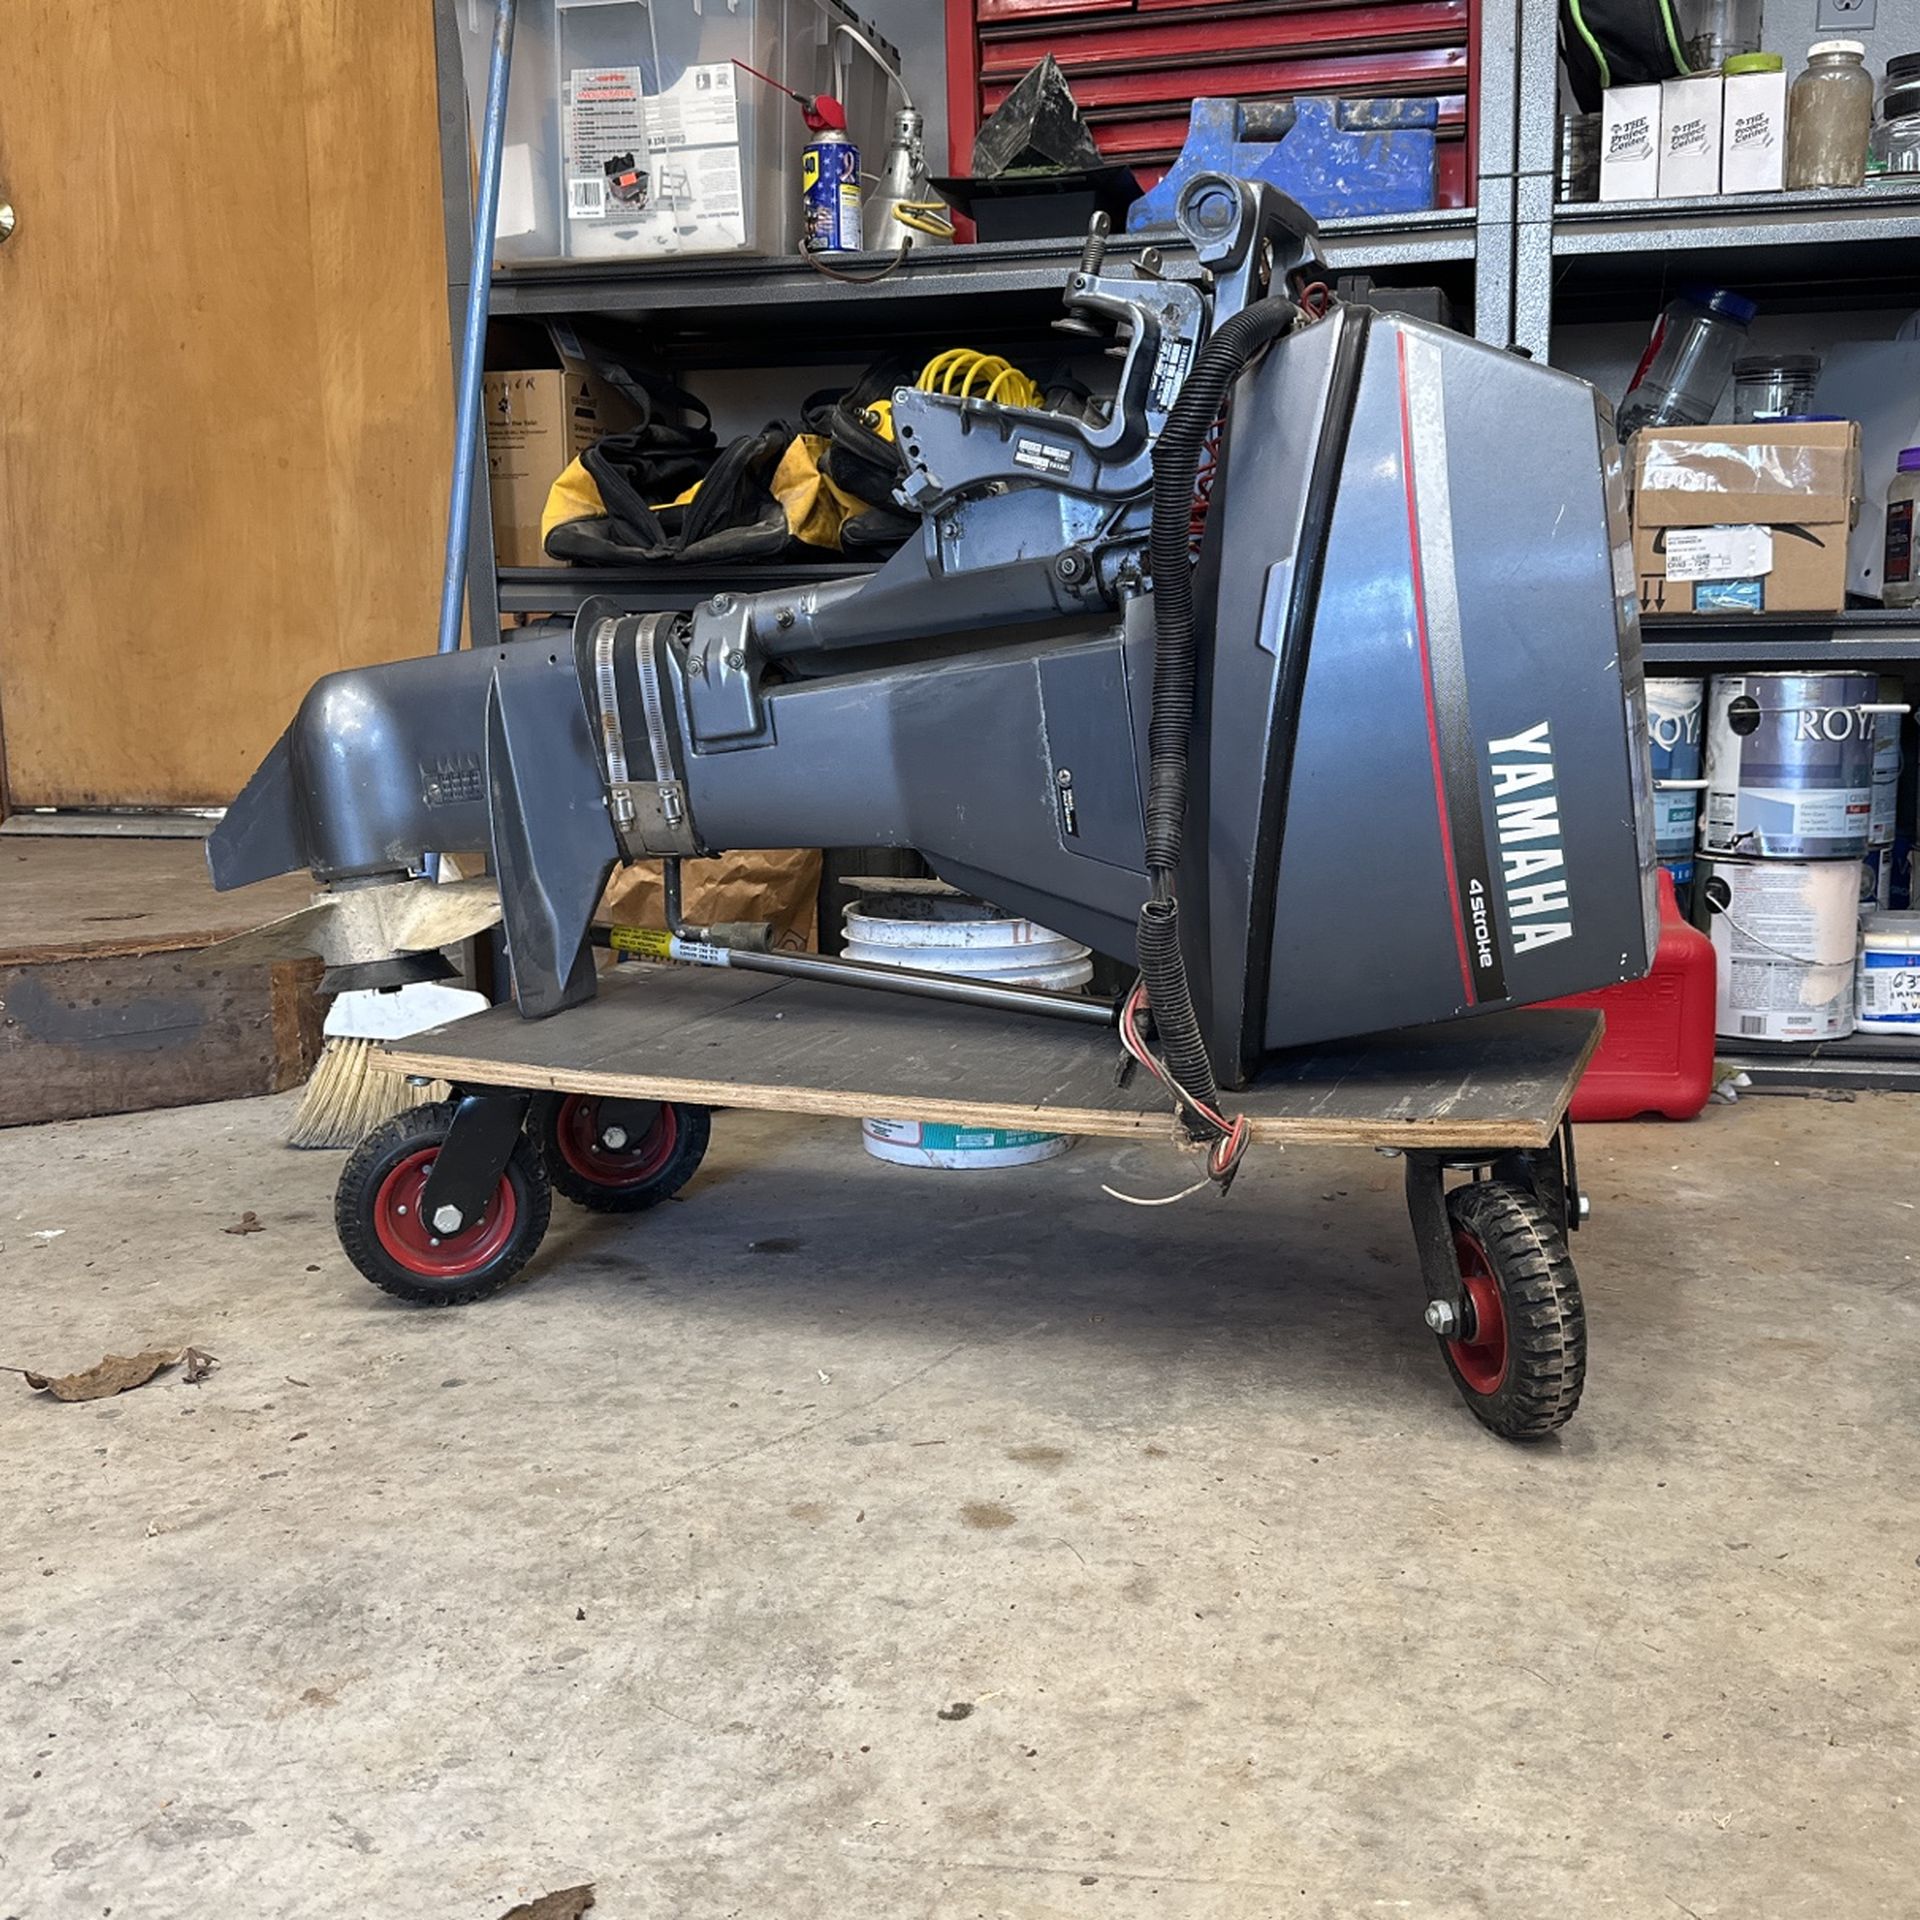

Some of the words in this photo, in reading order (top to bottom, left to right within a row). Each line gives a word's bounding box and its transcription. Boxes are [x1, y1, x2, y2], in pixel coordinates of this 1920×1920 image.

[1623, 116, 1647, 131] THE
[1682, 119, 1701, 131] THE
[1735, 118, 1769, 136] Project
[1745, 112, 1764, 126] THE
[1611, 126, 1649, 143] Project
[1671, 124, 1706, 143] Project
[1671, 134, 1704, 150] Center
[1735, 126, 1768, 143] Center
[1610, 136, 1647, 153] Center
[1488, 721, 1573, 954] YAMAHA
